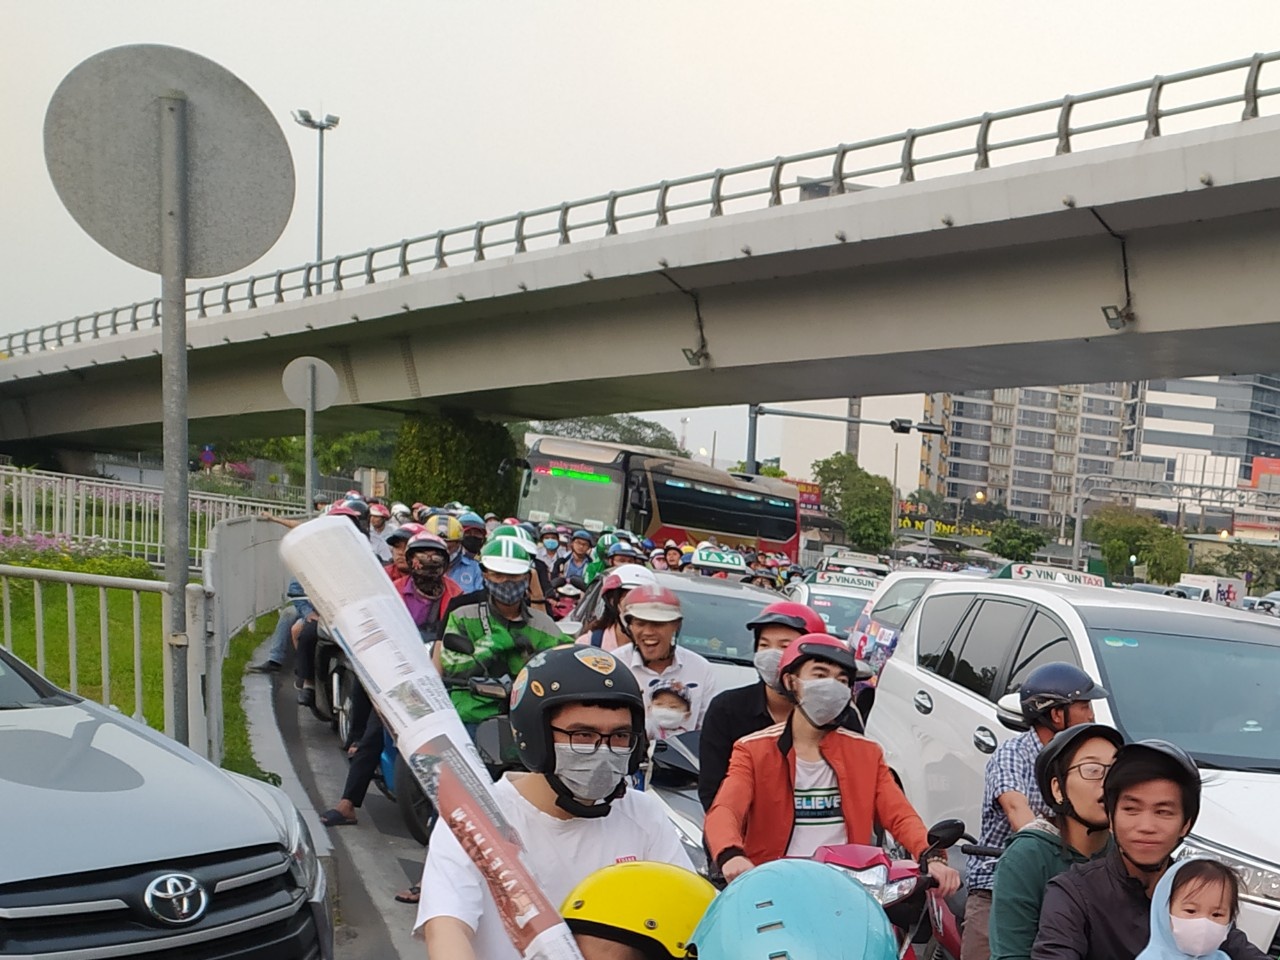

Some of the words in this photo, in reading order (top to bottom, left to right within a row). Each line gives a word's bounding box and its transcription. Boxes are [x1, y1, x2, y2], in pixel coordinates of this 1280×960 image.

[835, 574, 875, 588] VINASUN
[1082, 575, 1103, 587] TAXI
[1216, 583, 1237, 602] FedEx
[794, 795, 841, 810] ELIEVE
